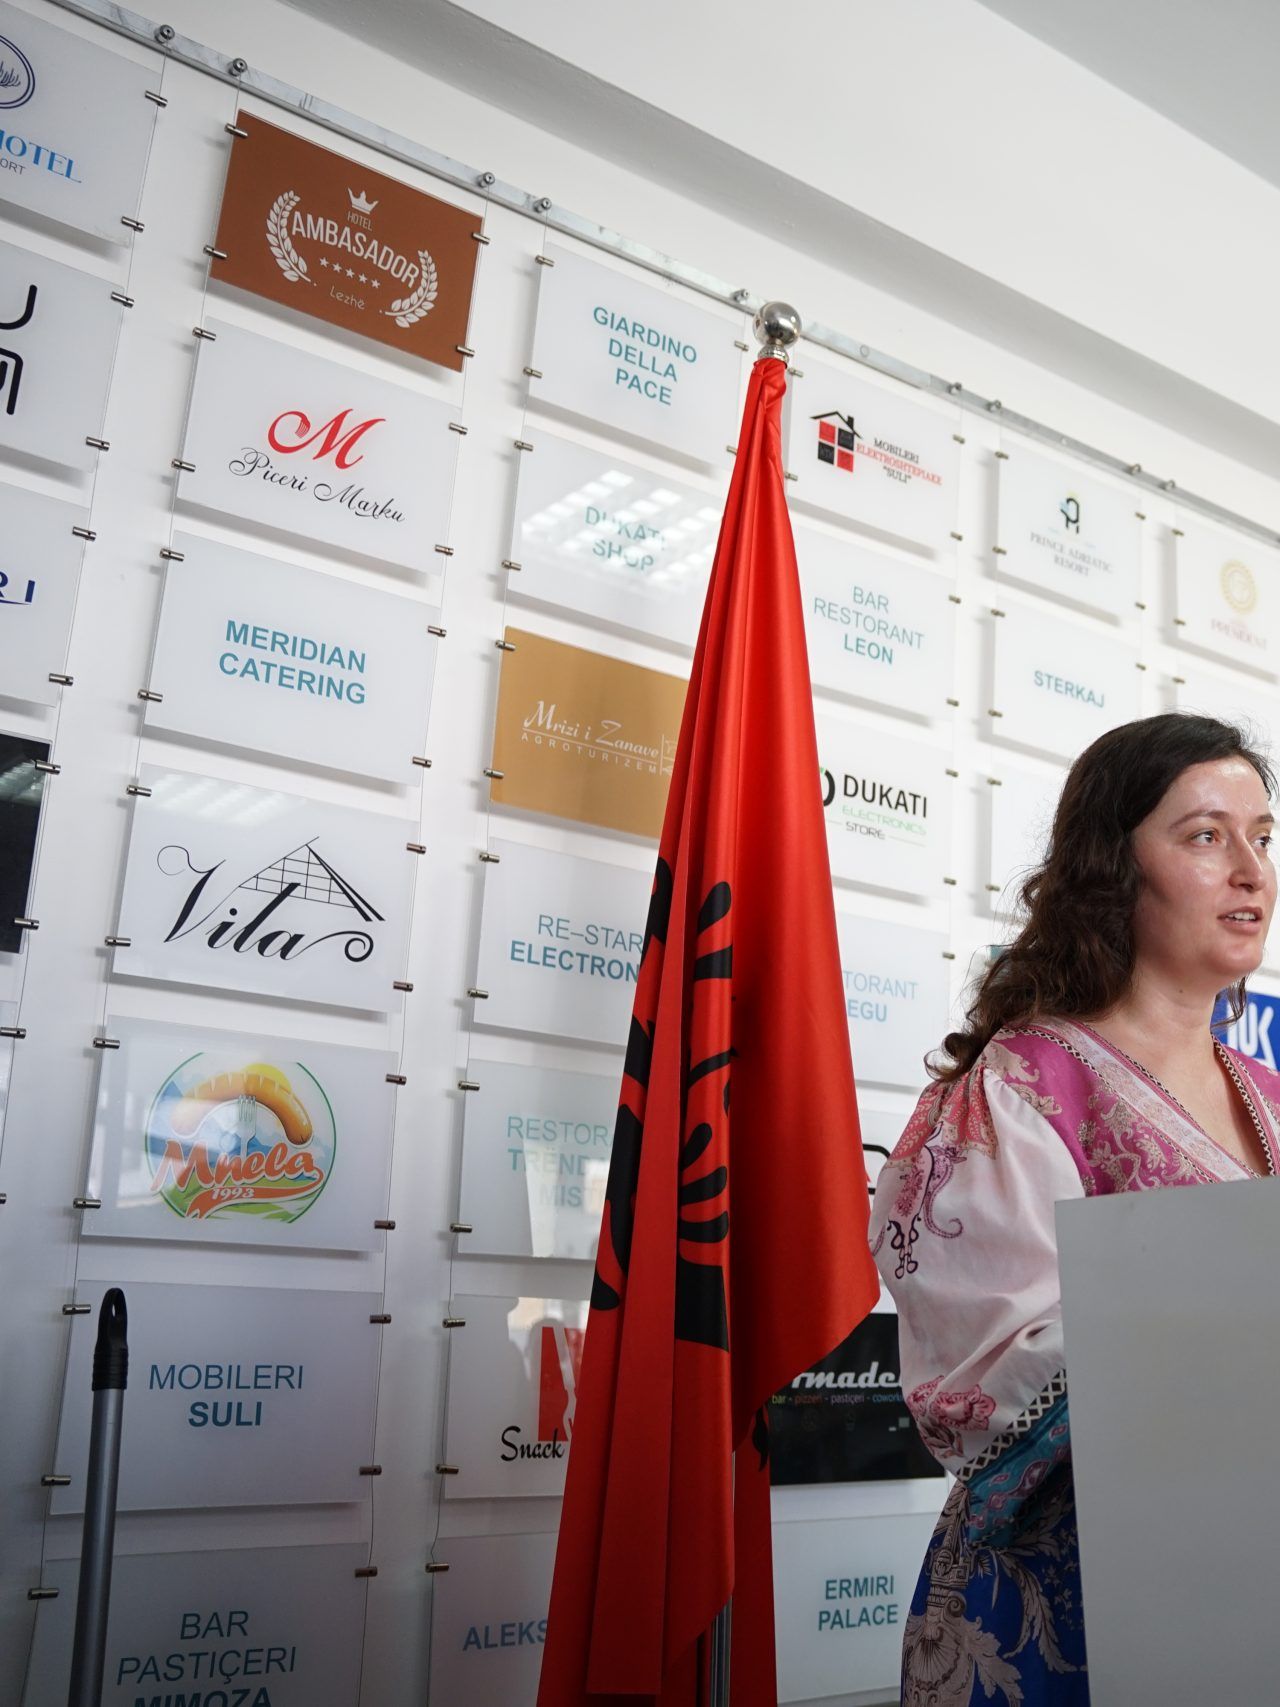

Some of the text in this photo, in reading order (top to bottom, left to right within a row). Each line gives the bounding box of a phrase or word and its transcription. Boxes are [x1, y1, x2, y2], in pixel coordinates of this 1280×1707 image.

[347, 211, 373, 232] HOTEL
[292, 210, 420, 289] AMBASADOR
[593, 306, 698, 364] GIARDINO
[608, 338, 678, 383] DELLA
[615, 370, 673, 405] PACE
[874, 438, 920, 464] MOBILERI
[228, 447, 406, 523] Piceri Marku
[852, 585, 890, 614] BAR
[814, 599, 925, 651] RESTORANT
[225, 620, 367, 674] MERIDIAN
[844, 634, 894, 665] LEON
[218, 652, 366, 705] CATERING
[1033, 669, 1105, 709] STERKAJ
[523, 700, 659, 759] Mrizi i Zanave
[521, 732, 657, 774] AGROTURIZEM
[843, 773, 928, 819] DUKATI
[846, 821, 886, 840] STORE
[510, 940, 640, 983] ELECTRON
[507, 1116, 612, 1147] RESTOR
[212, 1187, 255, 1200] 1993
[149, 1364, 304, 1390] MOBILERI
[188, 1401, 263, 1428] SULI
[501, 1425, 565, 1462] Snack
[824, 1574, 895, 1601] ERMIRI
[180, 1610, 249, 1640] BAR
[818, 1604, 899, 1632] PALACE
[117, 1646, 297, 1685] PASTIÇERI
